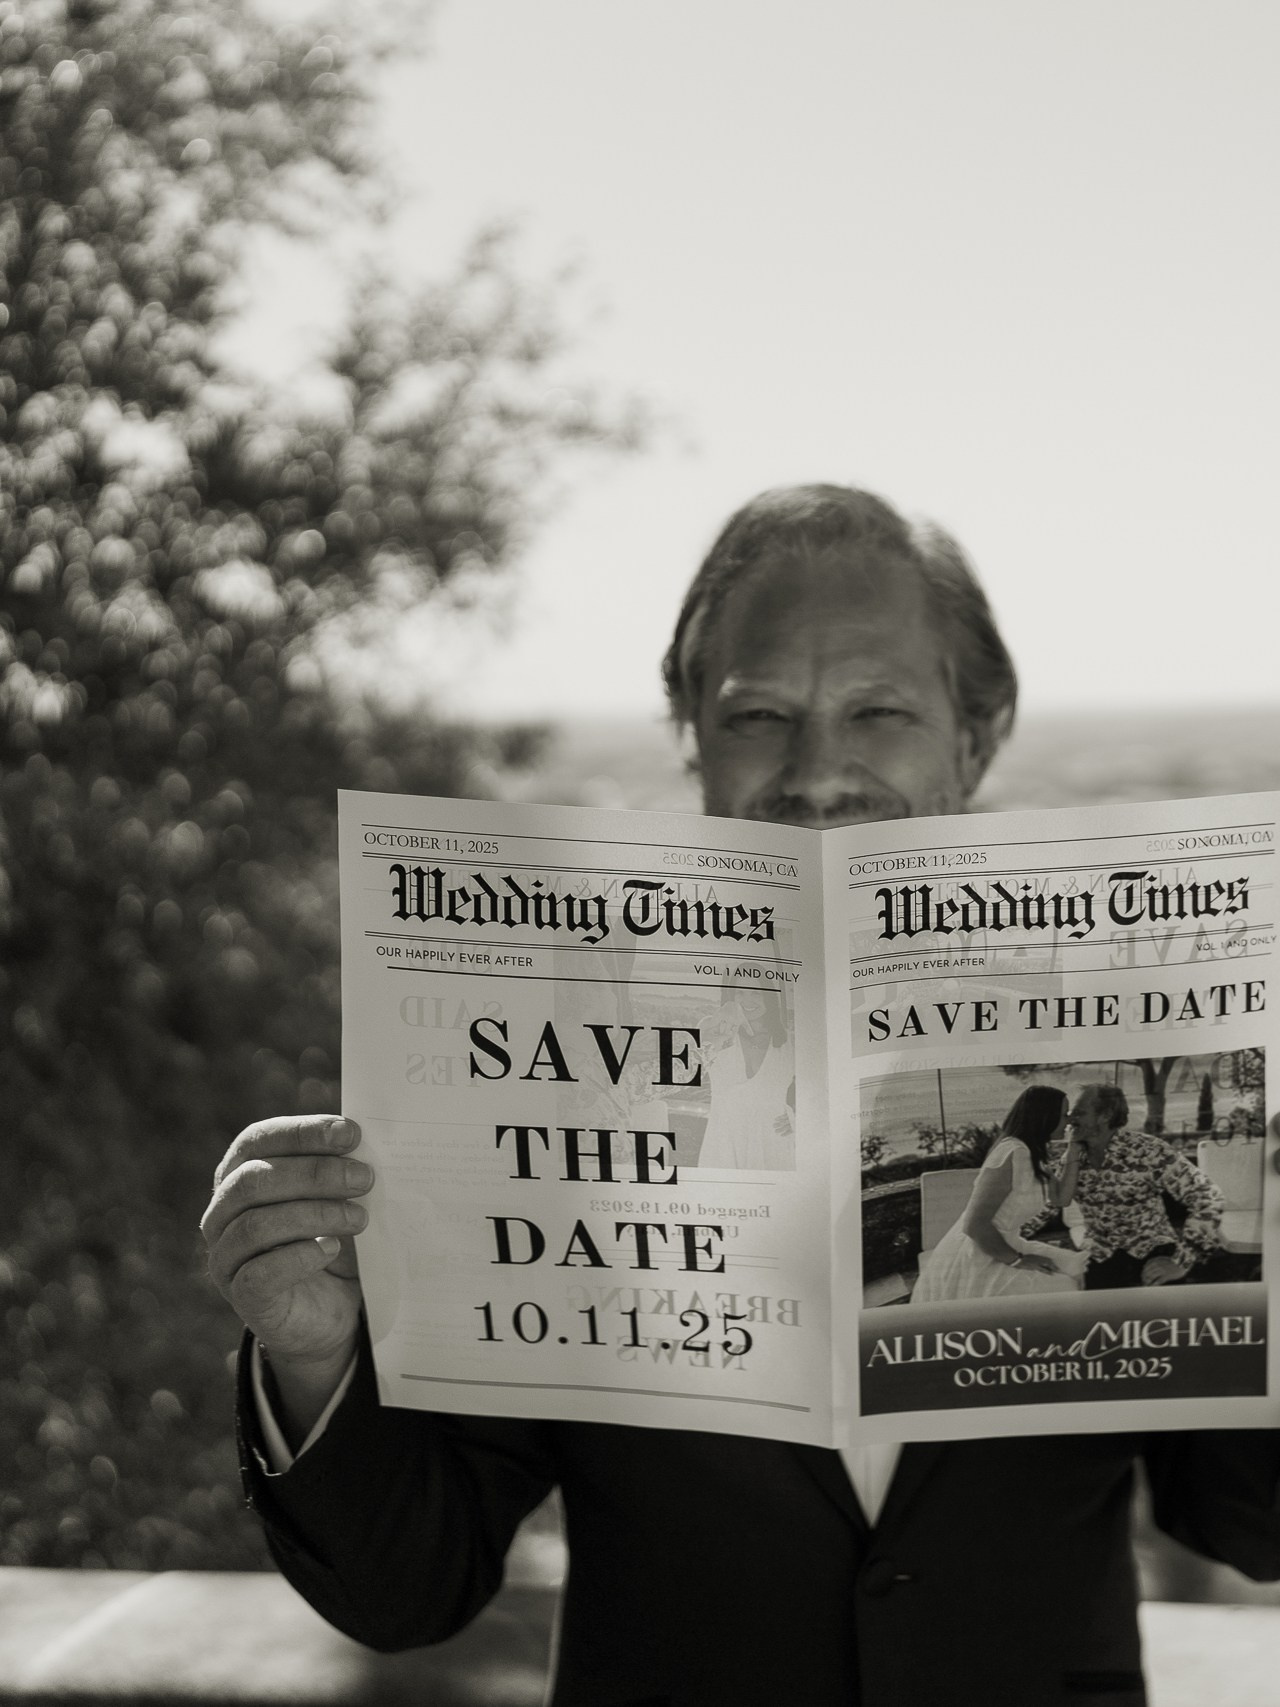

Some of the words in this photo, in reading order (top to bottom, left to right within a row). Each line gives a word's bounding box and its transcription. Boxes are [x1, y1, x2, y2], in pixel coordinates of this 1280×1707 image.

[364, 832, 441, 852] OCTOBER
[444, 840, 464, 855] 11,
[467, 839, 499, 855] 2025
[1177, 833, 1249, 851] SONOMA,
[1251, 830, 1272, 844] CA
[697, 856, 772, 876] SONOMA,
[776, 862, 798, 878] CA
[849, 855, 927, 876] OCTOBER
[932, 852, 953, 870] 11,
[955, 852, 987, 866] 2025
[389, 863, 609, 945] Wedding
[621, 879, 775, 943] Times
[874, 881, 1096, 940] Wedding
[1108, 870, 1250, 926] Times
[376, 946, 402, 958] OUR
[405, 948, 455, 962] HAPPILY
[459, 952, 491, 965] EVER
[494, 954, 533, 968] AFTER
[1227, 939, 1248, 949] AND
[1250, 935, 1277, 946] ONLY
[694, 965, 722, 976] VOL.
[725, 967, 730, 976] 1
[734, 967, 761, 979] AND
[765, 970, 800, 983] ONLY
[853, 967, 874, 978] OUR
[877, 961, 920, 975] HAPPILY
[923, 959, 951, 970] EVER
[953, 957, 985, 969] AFTER
[868, 1000, 999, 1042] SAVE
[1019, 994, 1120, 1030] THE
[1140, 980, 1266, 1024] DATE
[468, 1017, 702, 1087] SAVE
[495, 1124, 679, 1185] THE
[485, 1216, 726, 1273] DATE
[473, 1301, 753, 1356] 10.11.25
[867, 1326, 1023, 1367] ALLISON
[1101, 1316, 1264, 1347] MICHAEL
[953, 1361, 1081, 1387] OCTOBER
[1087, 1361, 1109, 1382] 11,
[1113, 1356, 1173, 1381] 2025
